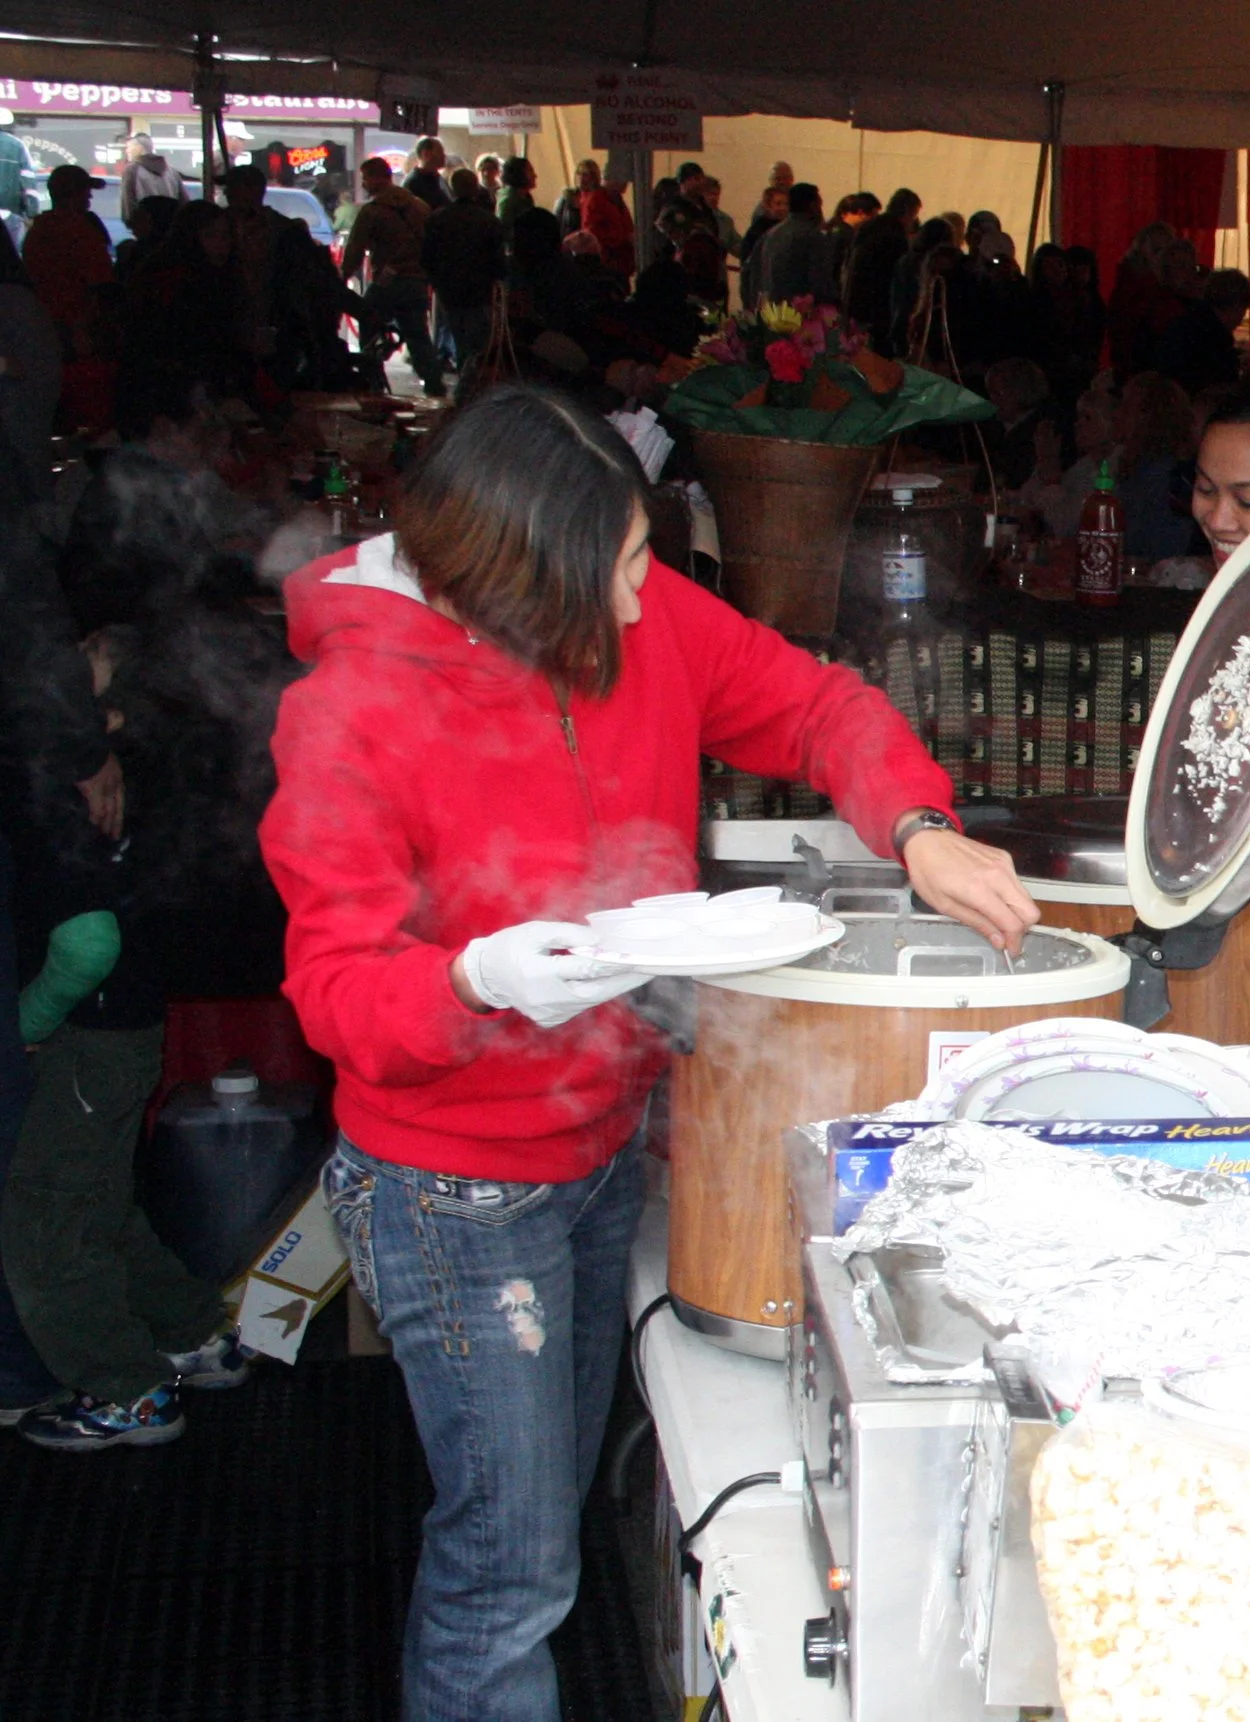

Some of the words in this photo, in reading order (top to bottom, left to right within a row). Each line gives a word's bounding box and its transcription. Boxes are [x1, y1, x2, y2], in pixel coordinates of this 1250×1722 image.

[32, 81, 172, 107] Peppers
[623, 95, 697, 110] ALCOHOL
[616, 113, 679, 127] BEYOND
[608, 131, 641, 144] THIS
[643, 131, 690, 145] POINT
[287, 146, 329, 167] Coors
[1051, 1121, 1160, 1138] Wrap
[261, 1230, 303, 1273] SOLO
